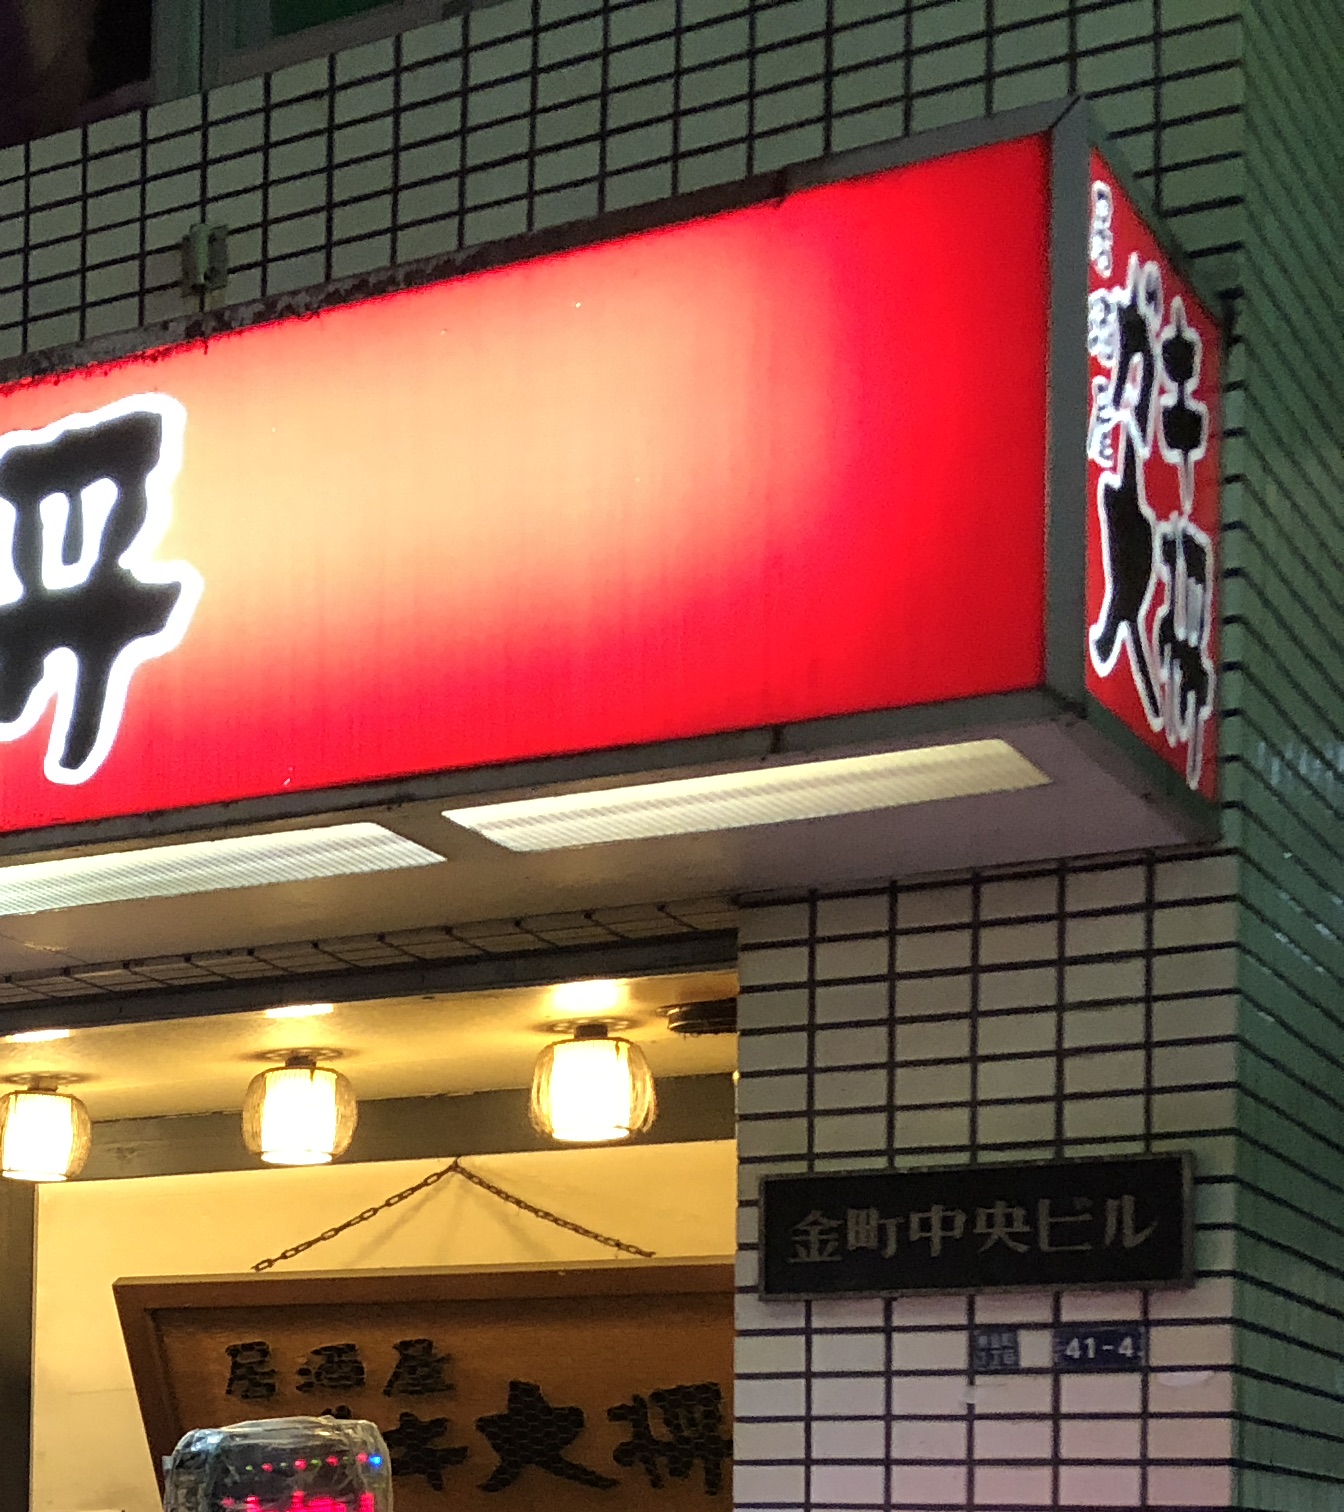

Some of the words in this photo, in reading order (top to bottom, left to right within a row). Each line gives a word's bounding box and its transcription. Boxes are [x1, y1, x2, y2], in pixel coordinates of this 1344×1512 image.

[786, 1193, 1160, 1264] 金町中央ビル
[225, 1338, 454, 1400] 居酒屋
[1064, 1335, 1134, 1360] 41-4
[352, 1380, 733, 1496] キ大将
